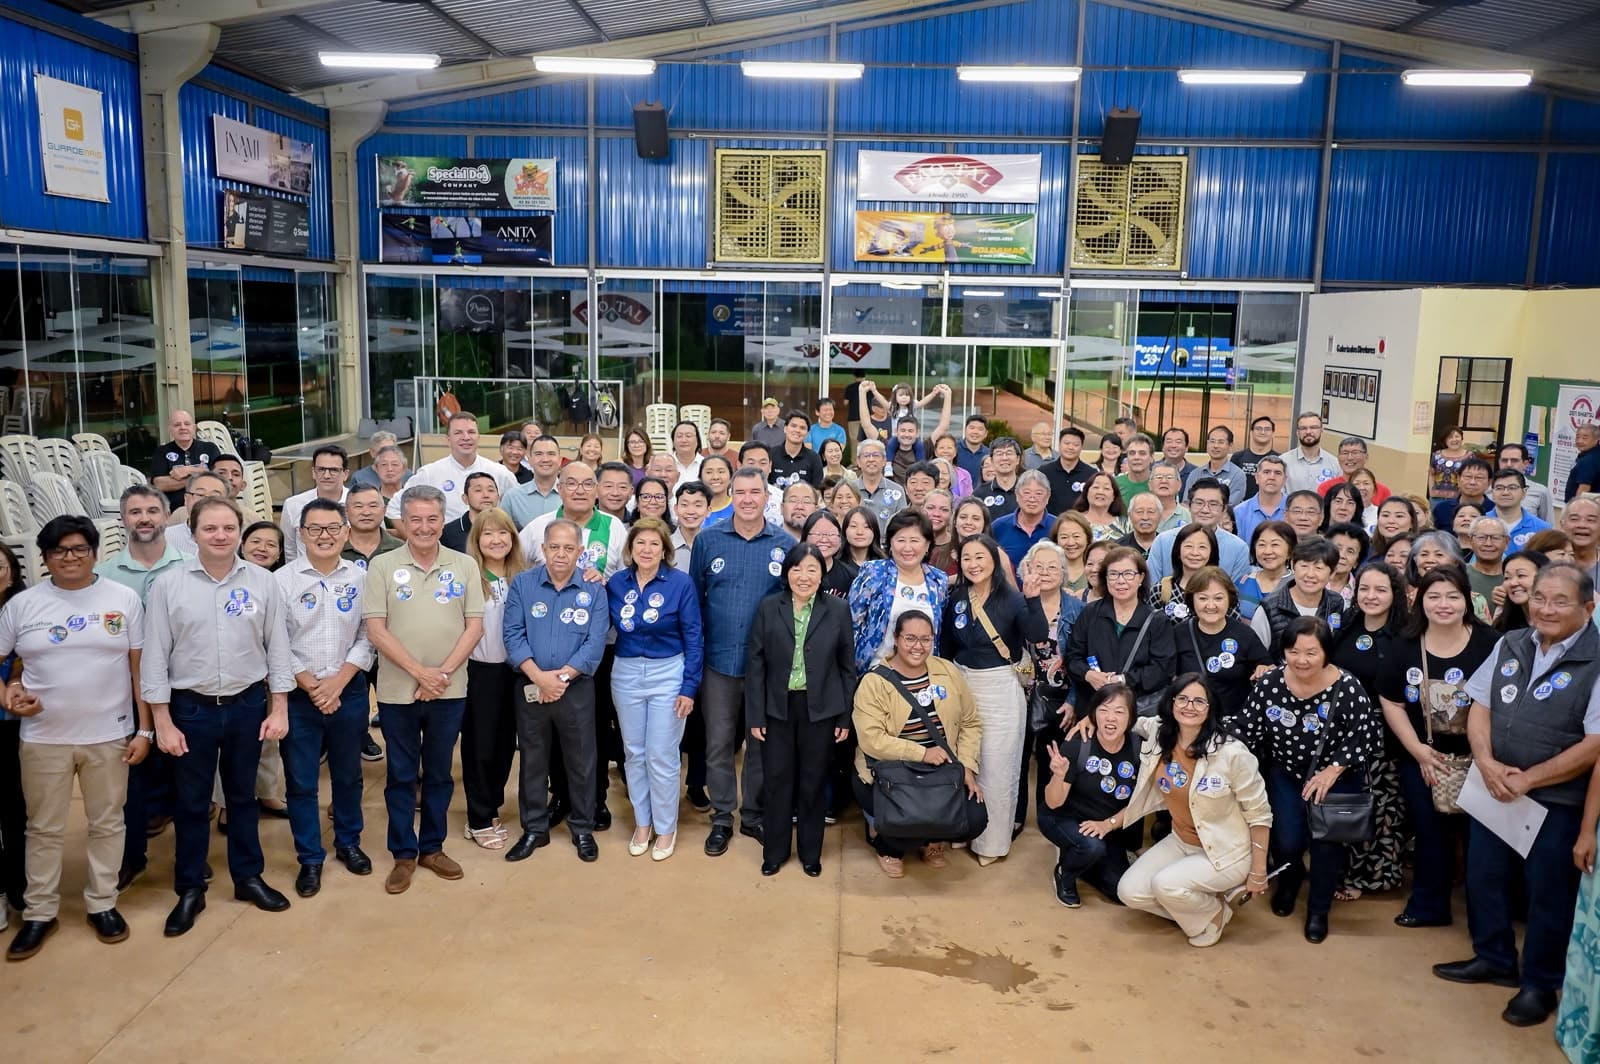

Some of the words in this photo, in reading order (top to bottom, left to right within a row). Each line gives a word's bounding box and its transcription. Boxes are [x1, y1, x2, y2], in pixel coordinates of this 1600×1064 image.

[428, 167, 467, 182] Special
[468, 165, 491, 183] Dog
[497, 226, 537, 239] ANITA
